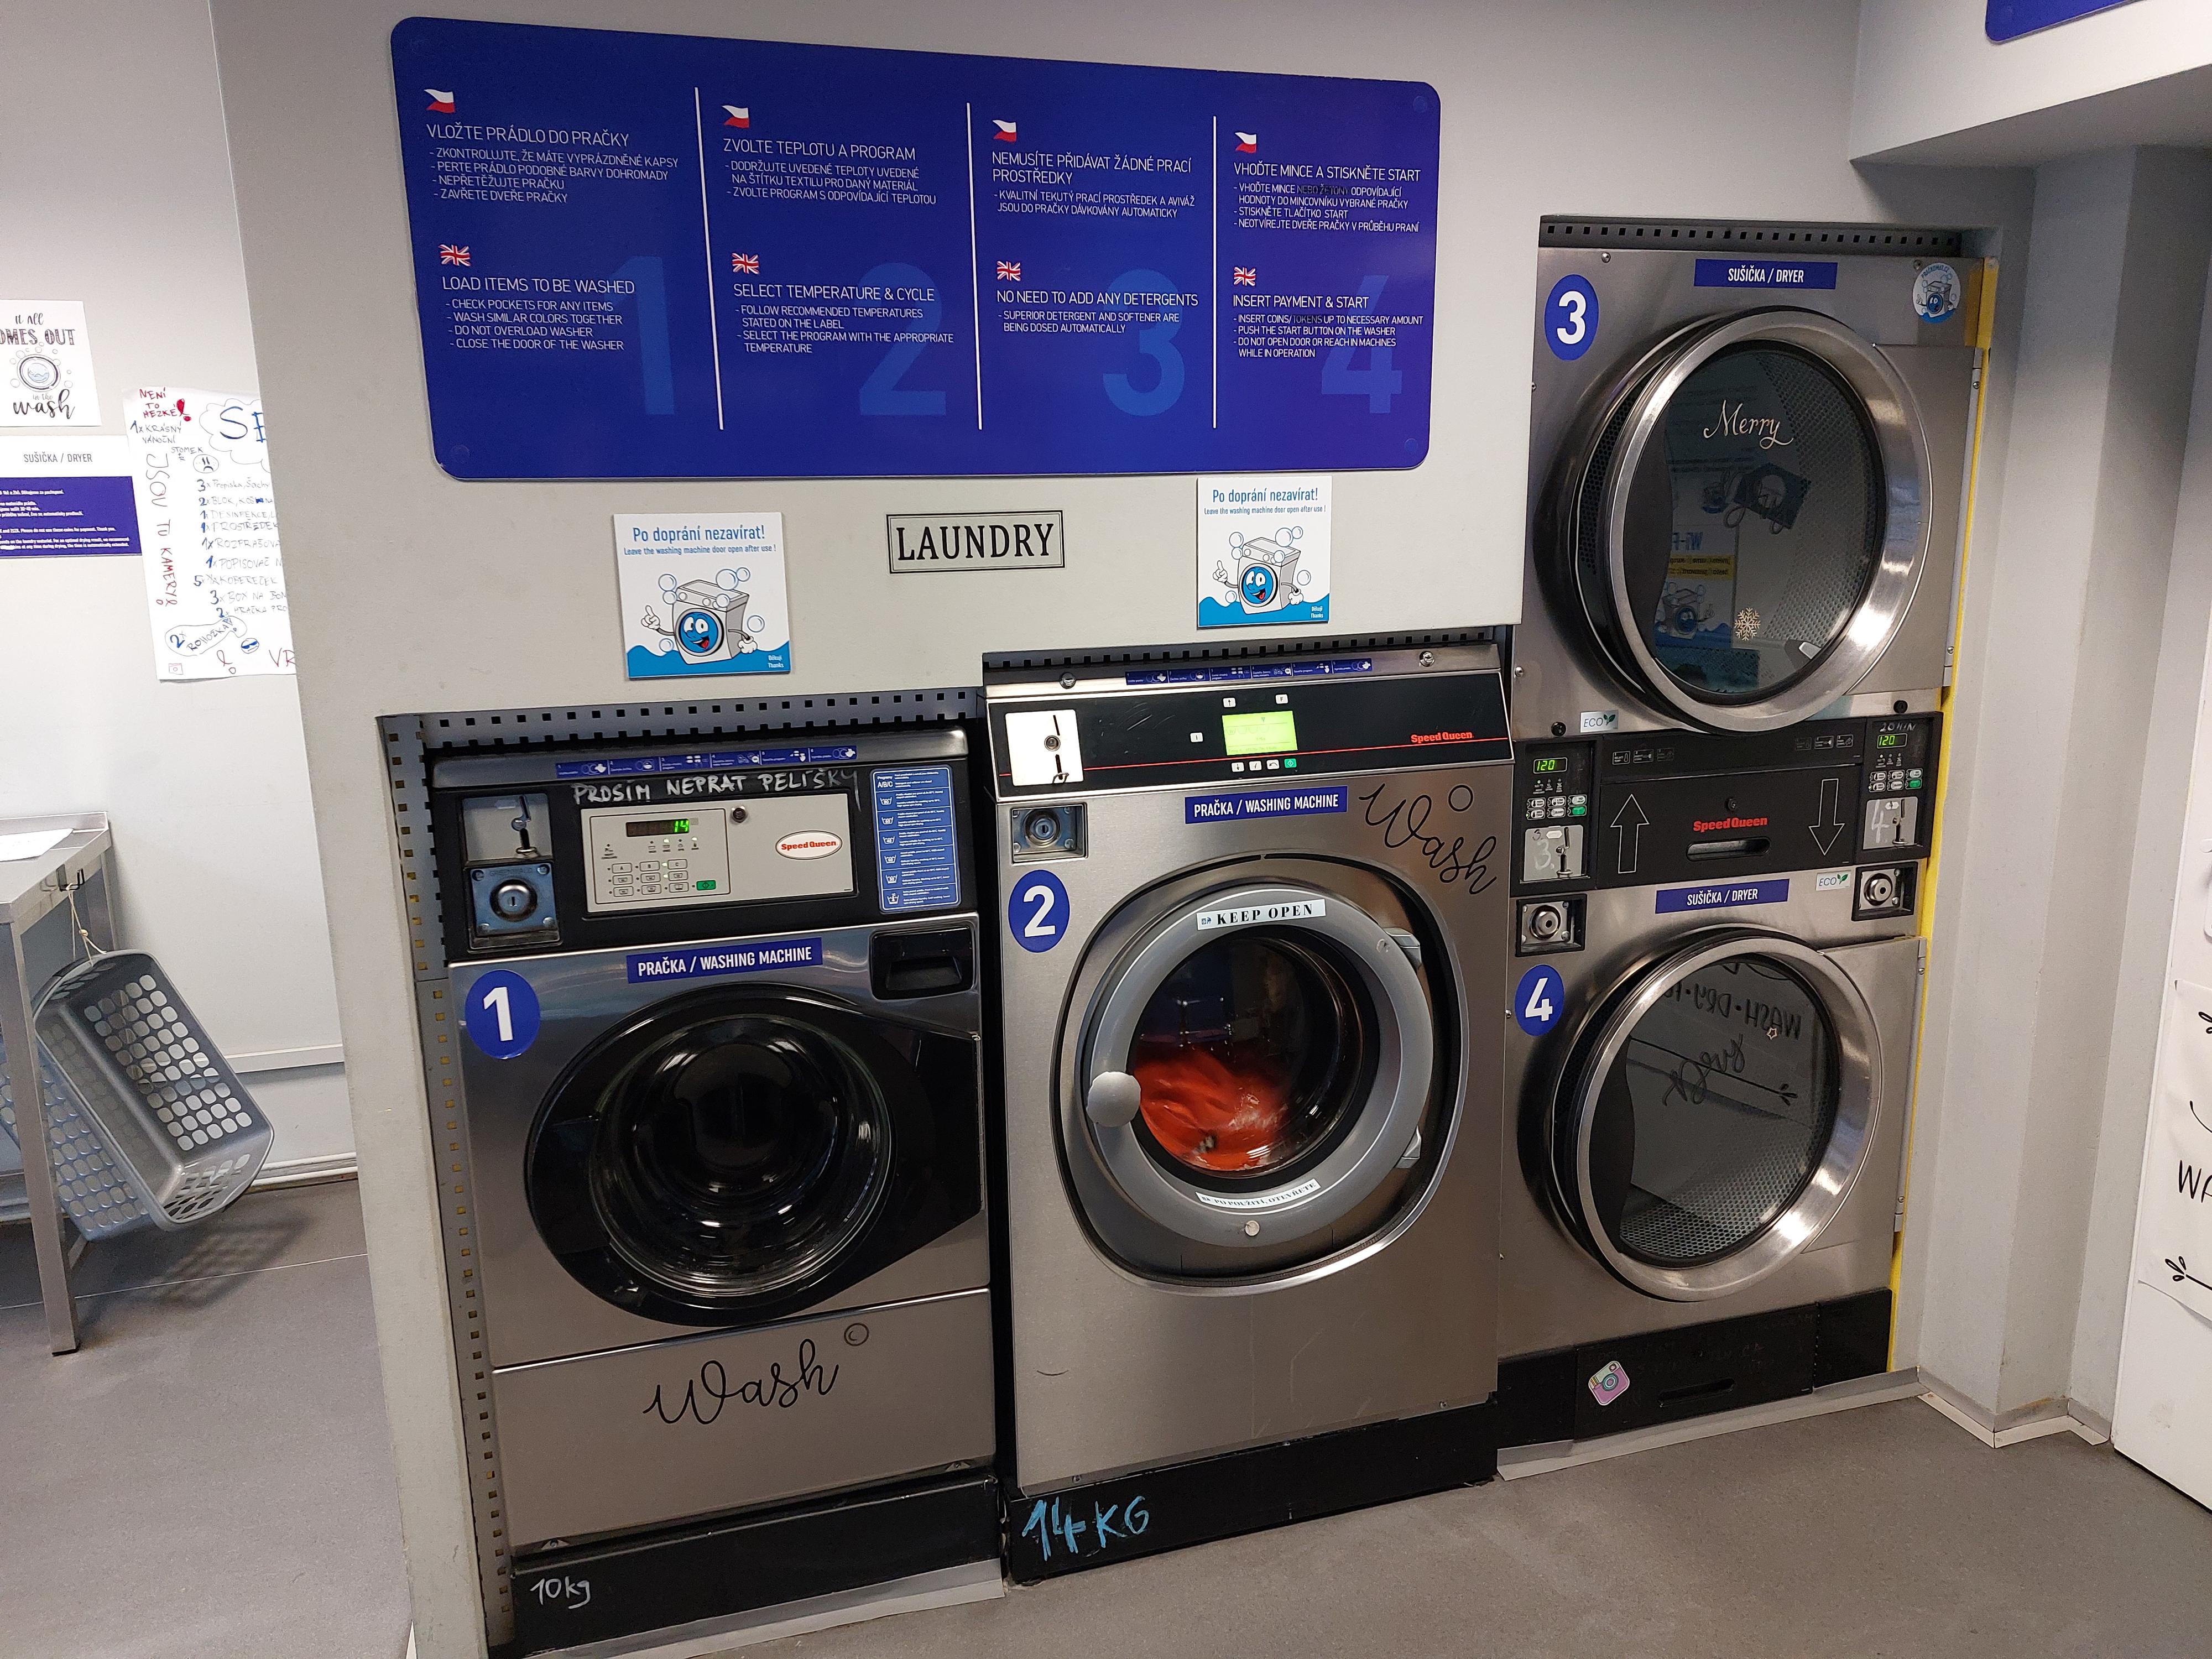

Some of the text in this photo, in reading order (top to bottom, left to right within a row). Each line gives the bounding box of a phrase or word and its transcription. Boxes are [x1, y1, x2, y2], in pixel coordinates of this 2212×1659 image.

[426, 121, 629, 147] VLOŽTE PRÁDLO DO PRAČKY
[723, 138, 915, 160] ZVOLTE TEPLOTU A PROGRAM
[992, 150, 1192, 173] NEMUSÍTE PŘIDÁVAT ŽÁDNÉ PRACÍ
[1234, 160, 1421, 181] VHOĎTE MINCE A STISKNĚTE START
[993, 167, 1073, 185] PROSTŘEDKY
[997, 202, 1177, 218] JSOU DO PRAČKY DÁVKOVÁNY AUTOMATICKY
[1239, 205, 1349, 219] STISKNĚTE TLAČÍTKO START
[1728, 265, 1765, 282] SUŠIČKA
[1776, 270, 1804, 283] DRYER
[442, 276, 635, 294] LOAD ITEMS TO BE WASHED
[734, 283, 935, 301] SELECT TEMPERATURE & CYCLE
[452, 299, 613, 311] CHECK POCKETS FOR ANY ITEMS
[997, 290, 1198, 306] NO NEED TO ADD ANY DETERGENTS
[1233, 294, 1369, 309] INSERT PAYMENT & START
[453, 312, 623, 325] WASH SIMILAR COLORS TOGETHER
[741, 305, 924, 318] FOLLOW RECOMMENDED TEMPERATURES
[1004, 310, 1180, 322] SUPERIOR DETERGENT AND SOFTENER ARE
[1238, 314, 1266, 323] INSERT
[1323, 315, 1334, 324] UP
[1335, 315, 1345, 324] TO
[1347, 315, 1390, 325] NECESSARY
[1391, 316, 1423, 325] AMOUNT
[1557, 290, 1587, 345] 3
[44, 328, 75, 345] OUT
[13, 388, 76, 420] wash
[1704, 399, 1794, 450] Merry
[23, 451, 58, 462] SUŠIČKA
[67, 453, 93, 462] DRYER
[1213, 487, 1318, 504] Po doprání nezavírat!
[633, 525, 765, 544] Po doprání nezavírat!
[896, 523, 1054, 561] LAUNDRY
[1584, 717, 1603, 728] ECO
[1411, 732, 1473, 744] Speed Queen
[1879, 735, 1895, 746] 120
[1537, 759, 1555, 771] 120
[666, 774, 747, 796] NEPRAT
[1194, 799, 1233, 817] PRAČKA
[1245, 797, 1291, 813] WASHING
[1295, 794, 1338, 809] MACHINE
[674, 820, 689, 832] 14
[1693, 817, 1767, 832] Speed Queen
[781, 840, 837, 851] Speed Queen
[1358, 782, 1497, 895] Wash
[1819, 877, 1837, 886] ECO
[1687, 890, 1722, 906] SUŠIČKA
[1732, 889, 1759, 901] DRYER
[1023, 885, 1056, 937] 2
[1217, 904, 1313, 925] KEEP OPEN
[638, 957, 686, 976] PRAČKA
[700, 952, 755, 970] WASHING
[759, 947, 812, 964] MACHINE
[1525, 977, 1553, 1021] 4
[482, 987, 514, 1042] 1
[643, 1338, 839, 1425] Wash
